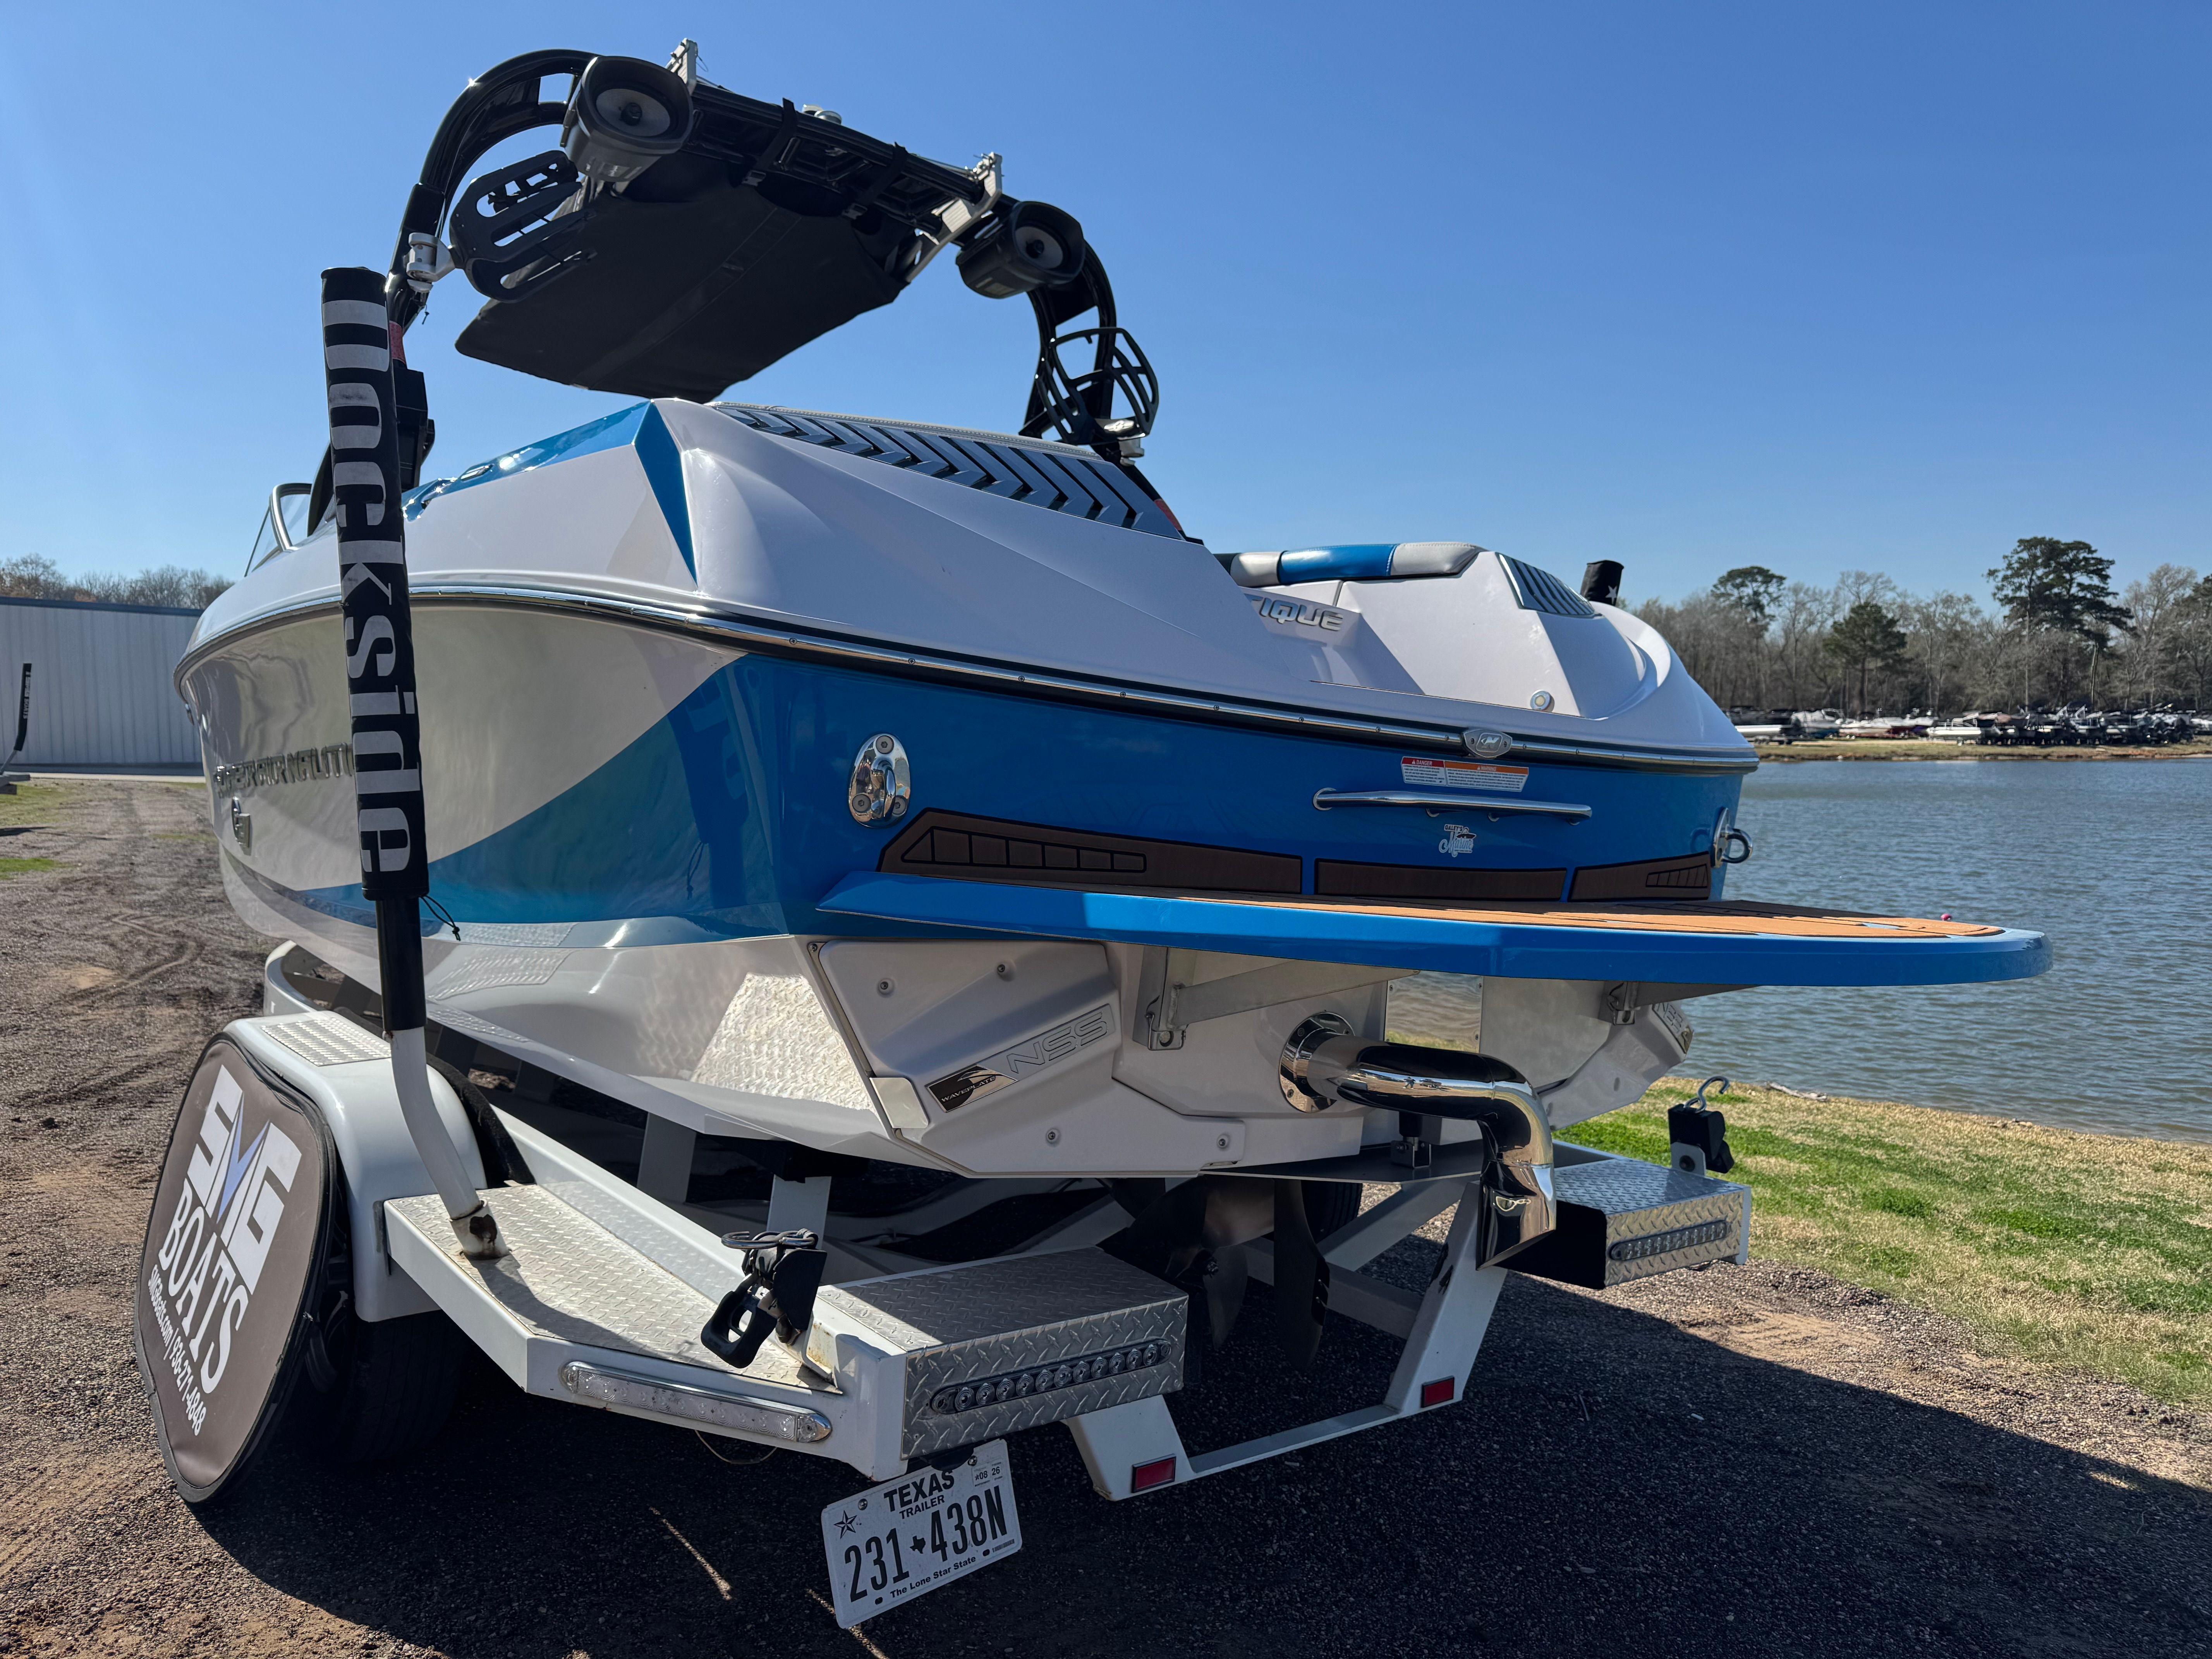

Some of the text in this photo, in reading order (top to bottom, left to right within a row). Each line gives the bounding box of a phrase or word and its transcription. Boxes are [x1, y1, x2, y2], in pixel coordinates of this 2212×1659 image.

[322, 299, 421, 872] Dockside
[1007, 1012, 1108, 1074] NSS
[941, 1077, 996, 1102] WAVEPLATE
[187, 1064, 302, 1296] SMG
[158, 1178, 249, 1393] BOATS
[883, 1471, 955, 1512] TEXAS
[991, 1466, 1000, 1476] 26
[899, 1494, 945, 1520] TRAILER
[844, 1485, 1008, 1602] 231 438N
[890, 1556, 976, 1598] The Lone Star State
